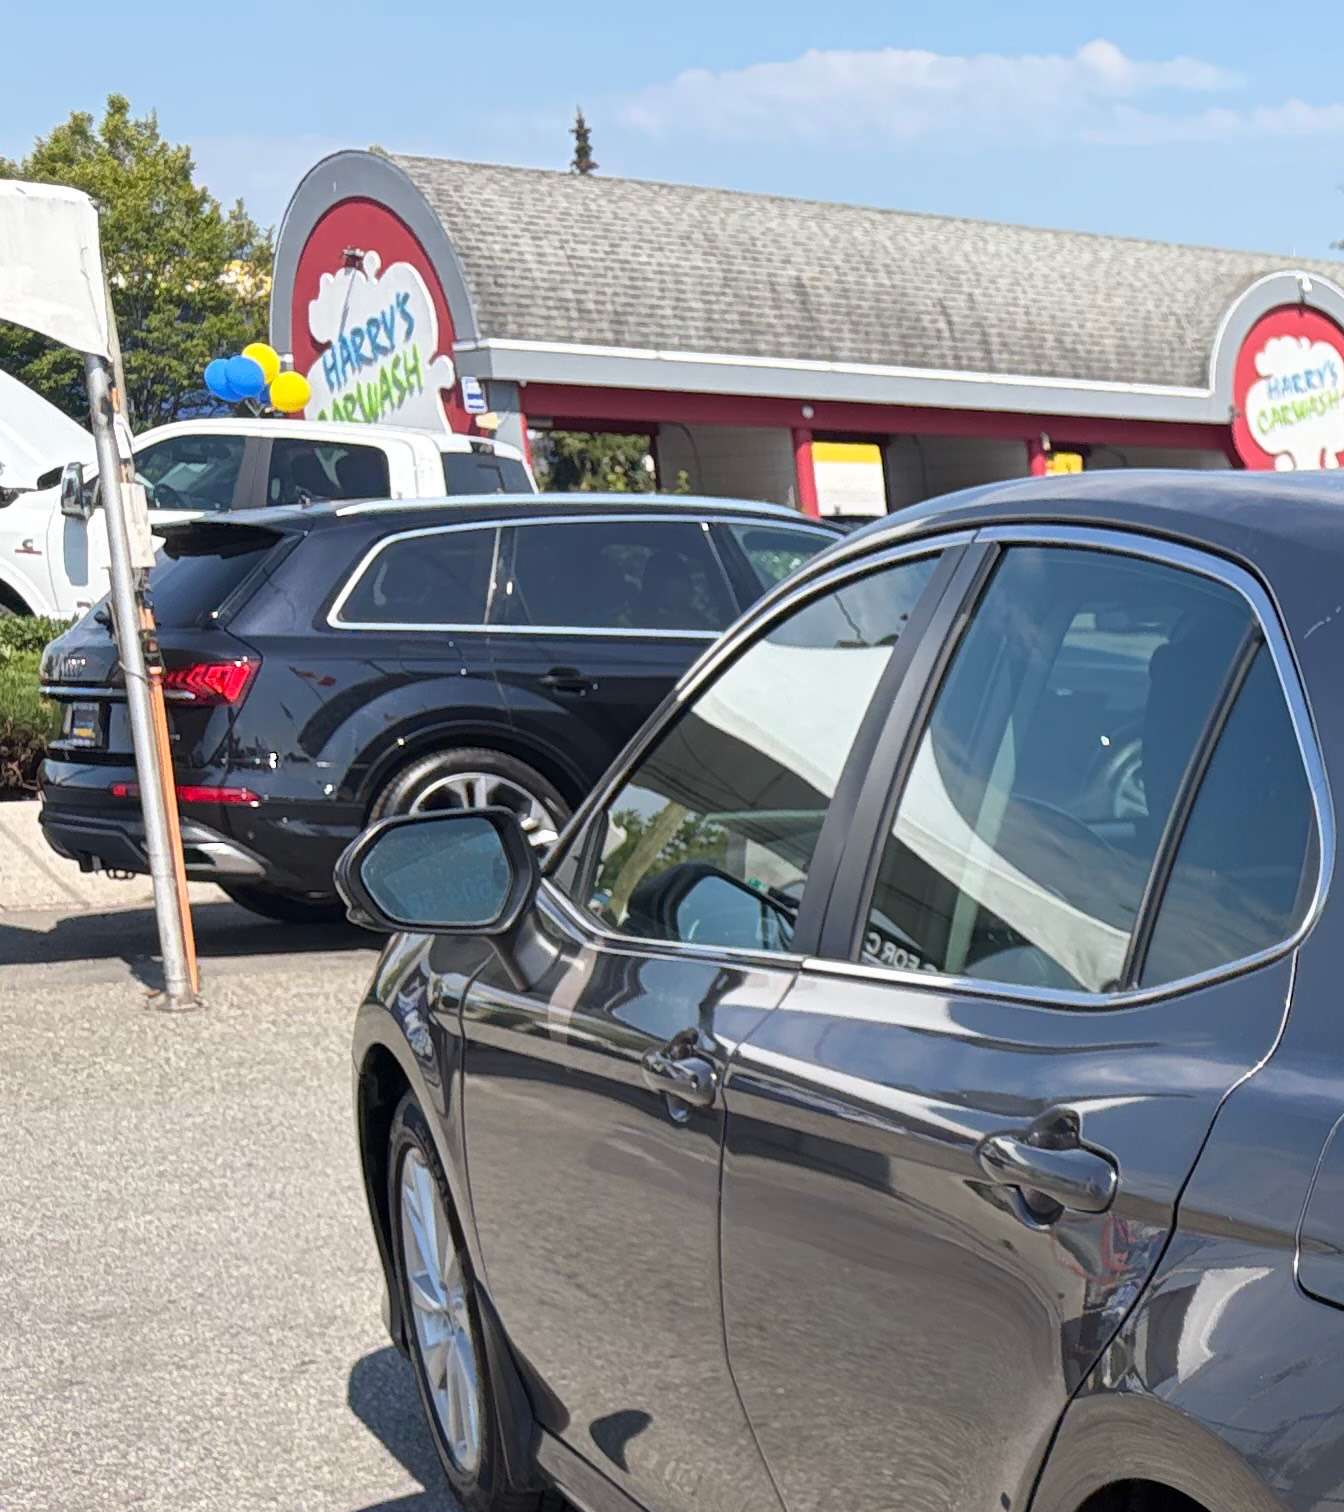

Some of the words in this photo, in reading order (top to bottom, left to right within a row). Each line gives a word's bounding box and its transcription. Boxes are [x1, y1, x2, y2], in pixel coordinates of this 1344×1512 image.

[322, 291, 415, 394] HARRY'S
[317, 343, 424, 424] ARWASH
[1256, 388, 1341, 435] CARWASH
[1265, 359, 1339, 401] HARRY'S
